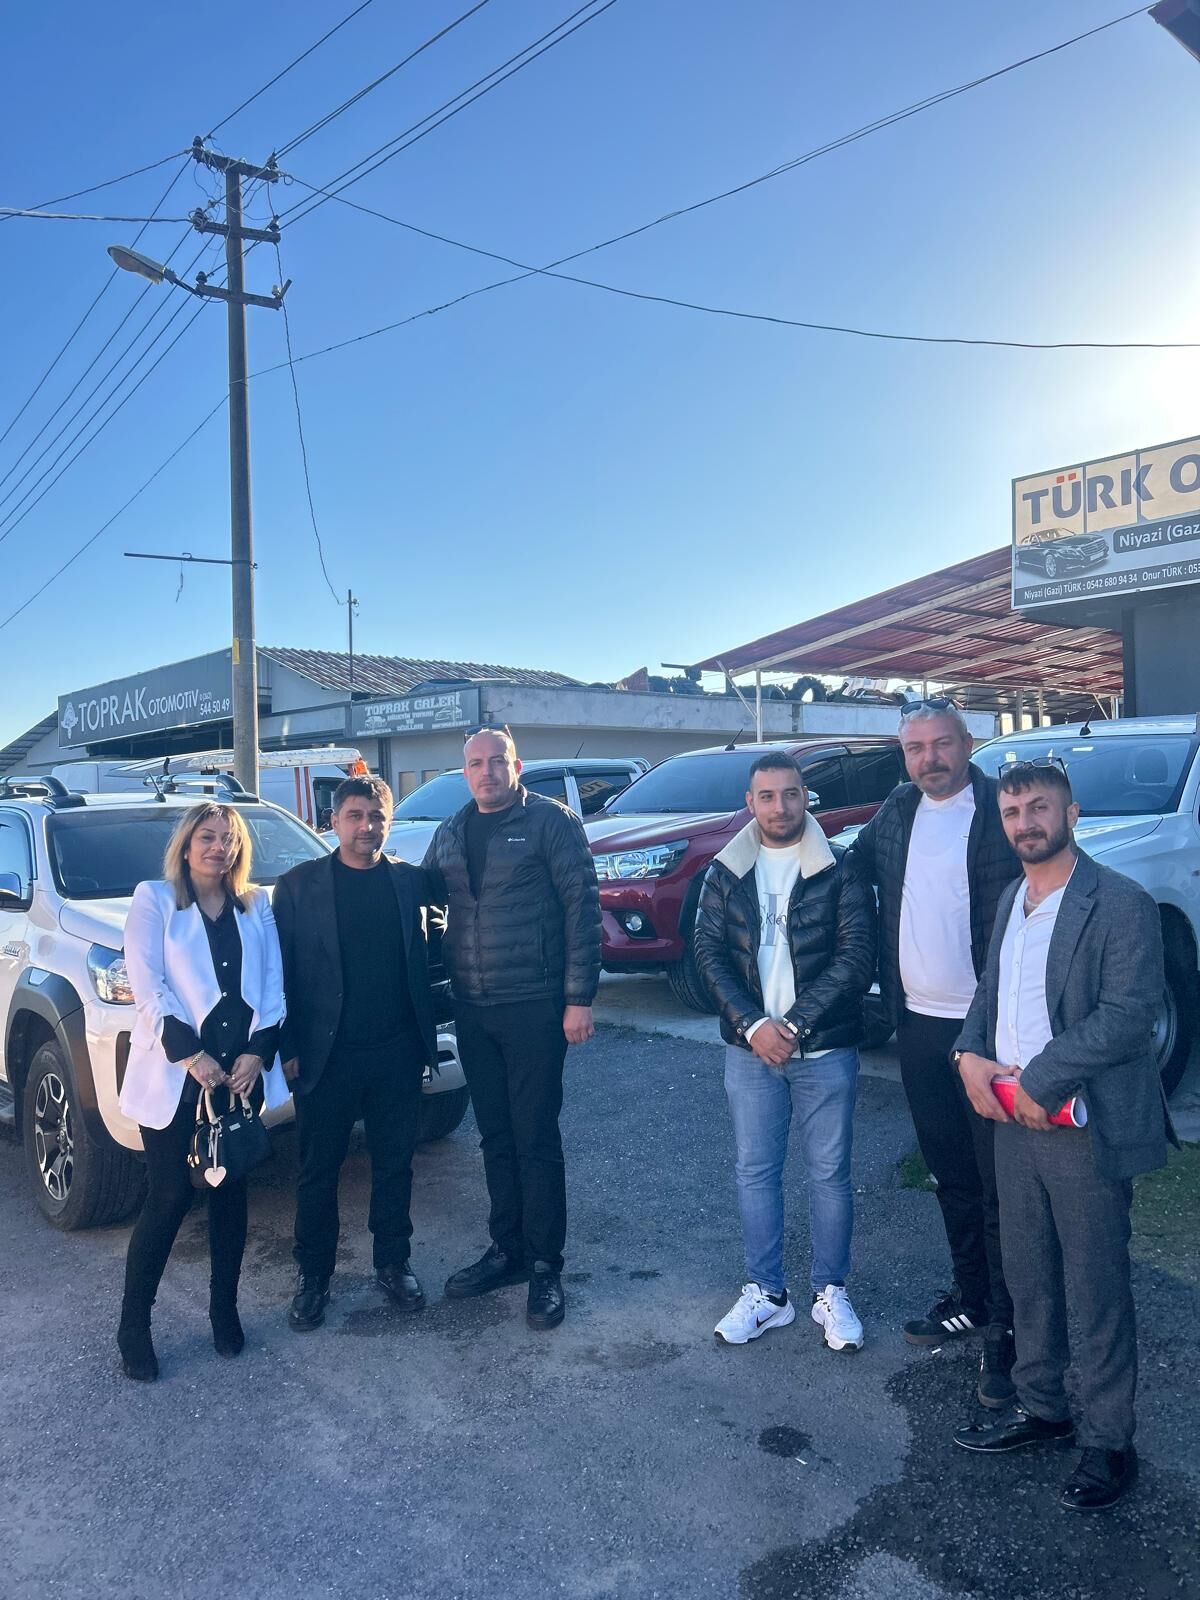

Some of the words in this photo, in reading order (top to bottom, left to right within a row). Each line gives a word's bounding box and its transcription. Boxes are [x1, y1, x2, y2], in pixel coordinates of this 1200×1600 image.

[1022, 463, 1155, 525] TÜRK
[1169, 453, 1200, 494] O
[1119, 527, 1162, 547] Niyazi
[1024, 588, 1043, 600] Niyazi
[1044, 584, 1063, 598] (Gazi)
[1063, 581, 1082, 593] TÜRK
[1086, 579, 1103, 590] 0542
[1104, 576, 1117, 587] 680
[1118, 575, 1127, 585] 94
[1129, 573, 1138, 583] 34
[1142, 571, 1161, 581] Onur
[1161, 565, 1183, 578] TÜRK
[78, 686, 148, 732] TOPRAK
[200, 701, 212, 716] 544
[212, 700, 221, 713] 50
[221, 698, 230, 712] 49
[365, 700, 410, 717] TOPRAK
